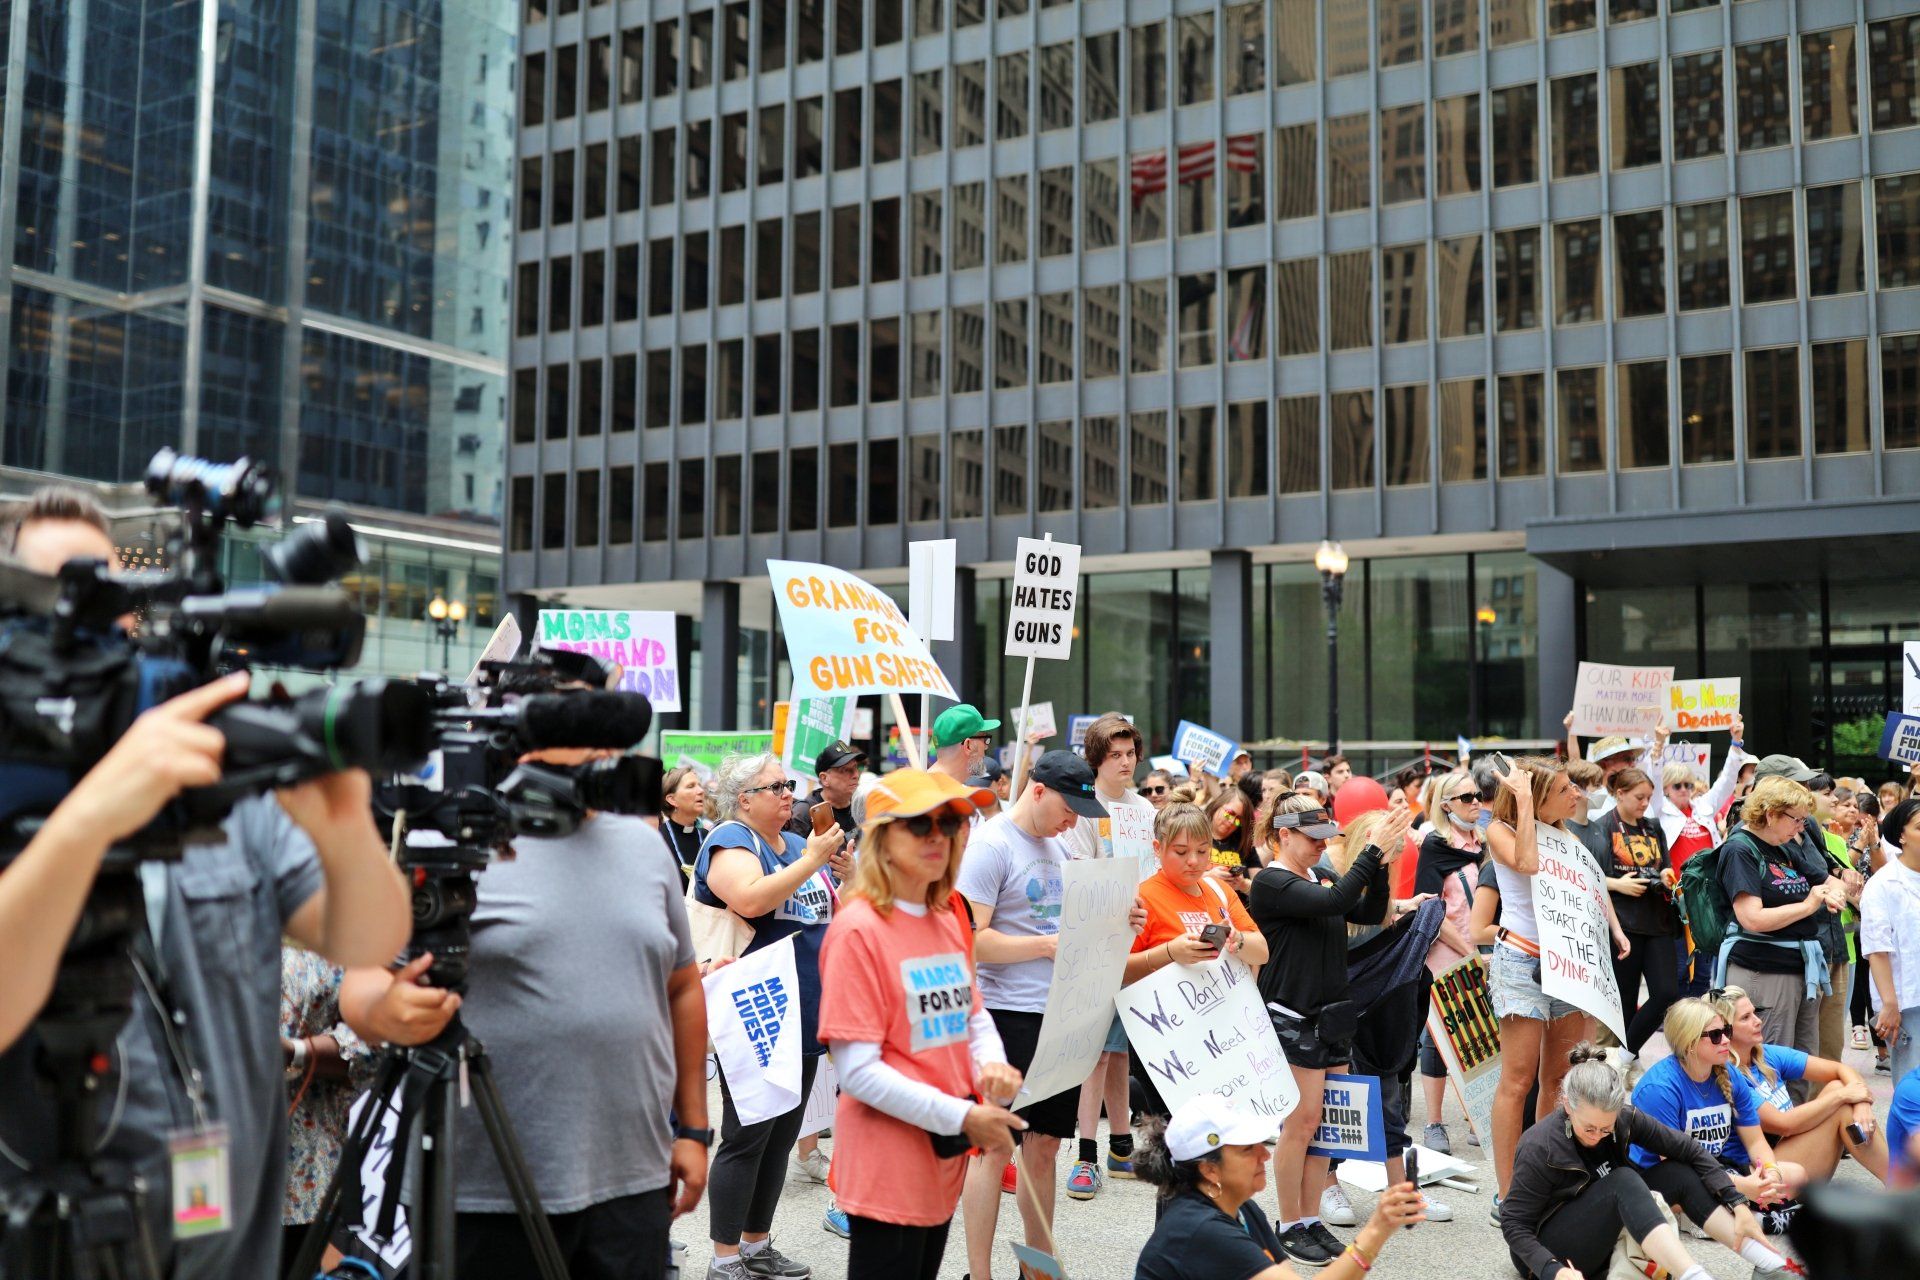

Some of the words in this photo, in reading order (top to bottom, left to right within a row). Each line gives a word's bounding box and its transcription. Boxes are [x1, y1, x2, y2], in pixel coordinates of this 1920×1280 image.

[1026, 552, 1062, 577] GOD
[1014, 585, 1073, 611] HATES
[542, 612, 631, 642] MOMS
[853, 617, 904, 647] FOR
[1014, 620, 1062, 644] GUNS
[557, 638, 666, 667] MAND
[615, 668, 675, 701] ION
[809, 654, 875, 691] GUN
[875, 652, 950, 694] SAFETY
[1587, 668, 1623, 686] OUR
[1631, 671, 1671, 689] KIDS
[1595, 689, 1627, 701] MATTER
[1631, 690, 1655, 703] MORE
[1580, 703, 1614, 723] THAN
[1185, 740, 1203, 751] FOR
[1204, 746, 1223, 759] OUR
[1188, 731, 1220, 750] MARCH
[1896, 747, 1920, 762] LIV
[1114, 807, 1142, 824] TURN
[1538, 854, 1586, 891] SCHOOLS
[1064, 878, 1130, 930] COMMON
[1540, 879, 1556, 901] SO
[1561, 890, 1583, 911] THE
[1178, 912, 1208, 923] THIS
[1541, 904, 1578, 934] START
[1058, 933, 1121, 982] SENSE
[1561, 935, 1597, 967] THE
[909, 962, 964, 992] MARCH
[1547, 949, 1591, 984] DYING
[748, 982, 776, 1022] FOR
[919, 990, 952, 1015] FOR
[1058, 978, 1103, 1023] GUN
[1129, 989, 1184, 1037] We
[1177, 969, 1225, 1011] Don't
[1220, 958, 1250, 990] Need
[731, 988, 766, 1042] LIVES
[921, 1011, 966, 1040] LIVES
[1148, 1050, 1201, 1086] We
[1203, 1024, 1246, 1060] Need
[1250, 1089, 1290, 1117] Nice
[1322, 1088, 1351, 1107] RCH
[1329, 1107, 1362, 1127] OUR
[1691, 1111, 1727, 1130] MARCH
[1313, 1125, 1341, 1144] VES
